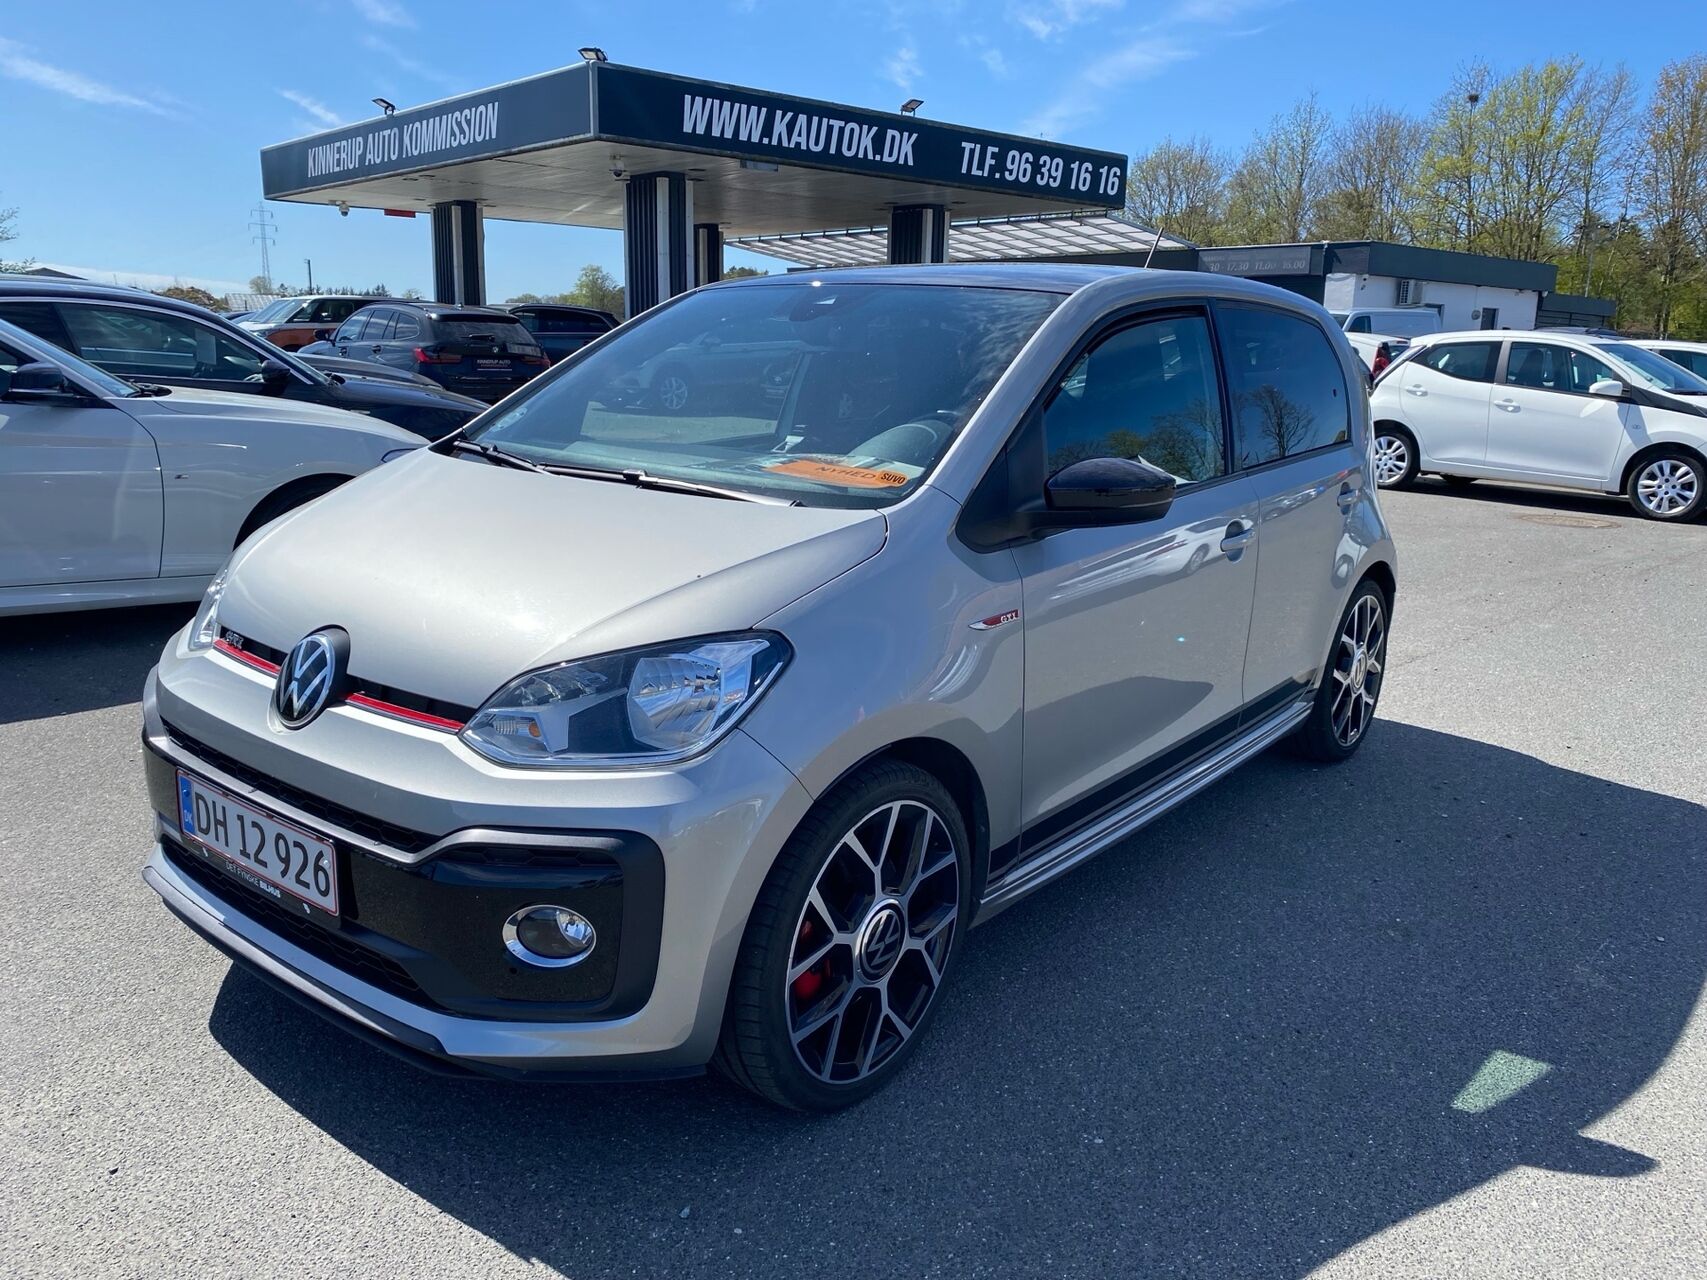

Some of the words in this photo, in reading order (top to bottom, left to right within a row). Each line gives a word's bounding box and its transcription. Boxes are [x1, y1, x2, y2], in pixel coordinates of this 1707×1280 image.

[307, 137, 364, 178] KINNERUP
[365, 127, 400, 166] AUTO
[402, 102, 499, 159] KOMMISSION
[682, 94, 919, 167] WWW.KAUTOK.DK
[961, 141, 1000, 179] TLF.
[1004, 150, 1033, 184] 96
[1036, 157, 1064, 188] 39
[1070, 161, 1092, 192] 16
[1098, 165, 1121, 196] 16
[816, 466, 876, 480] NYHED
[880, 472, 906, 485] SUVO
[184, 809, 193, 825] DK
[194, 792, 229, 848] DH
[236, 814, 268, 869] 12
[274, 832, 331, 898] 926
